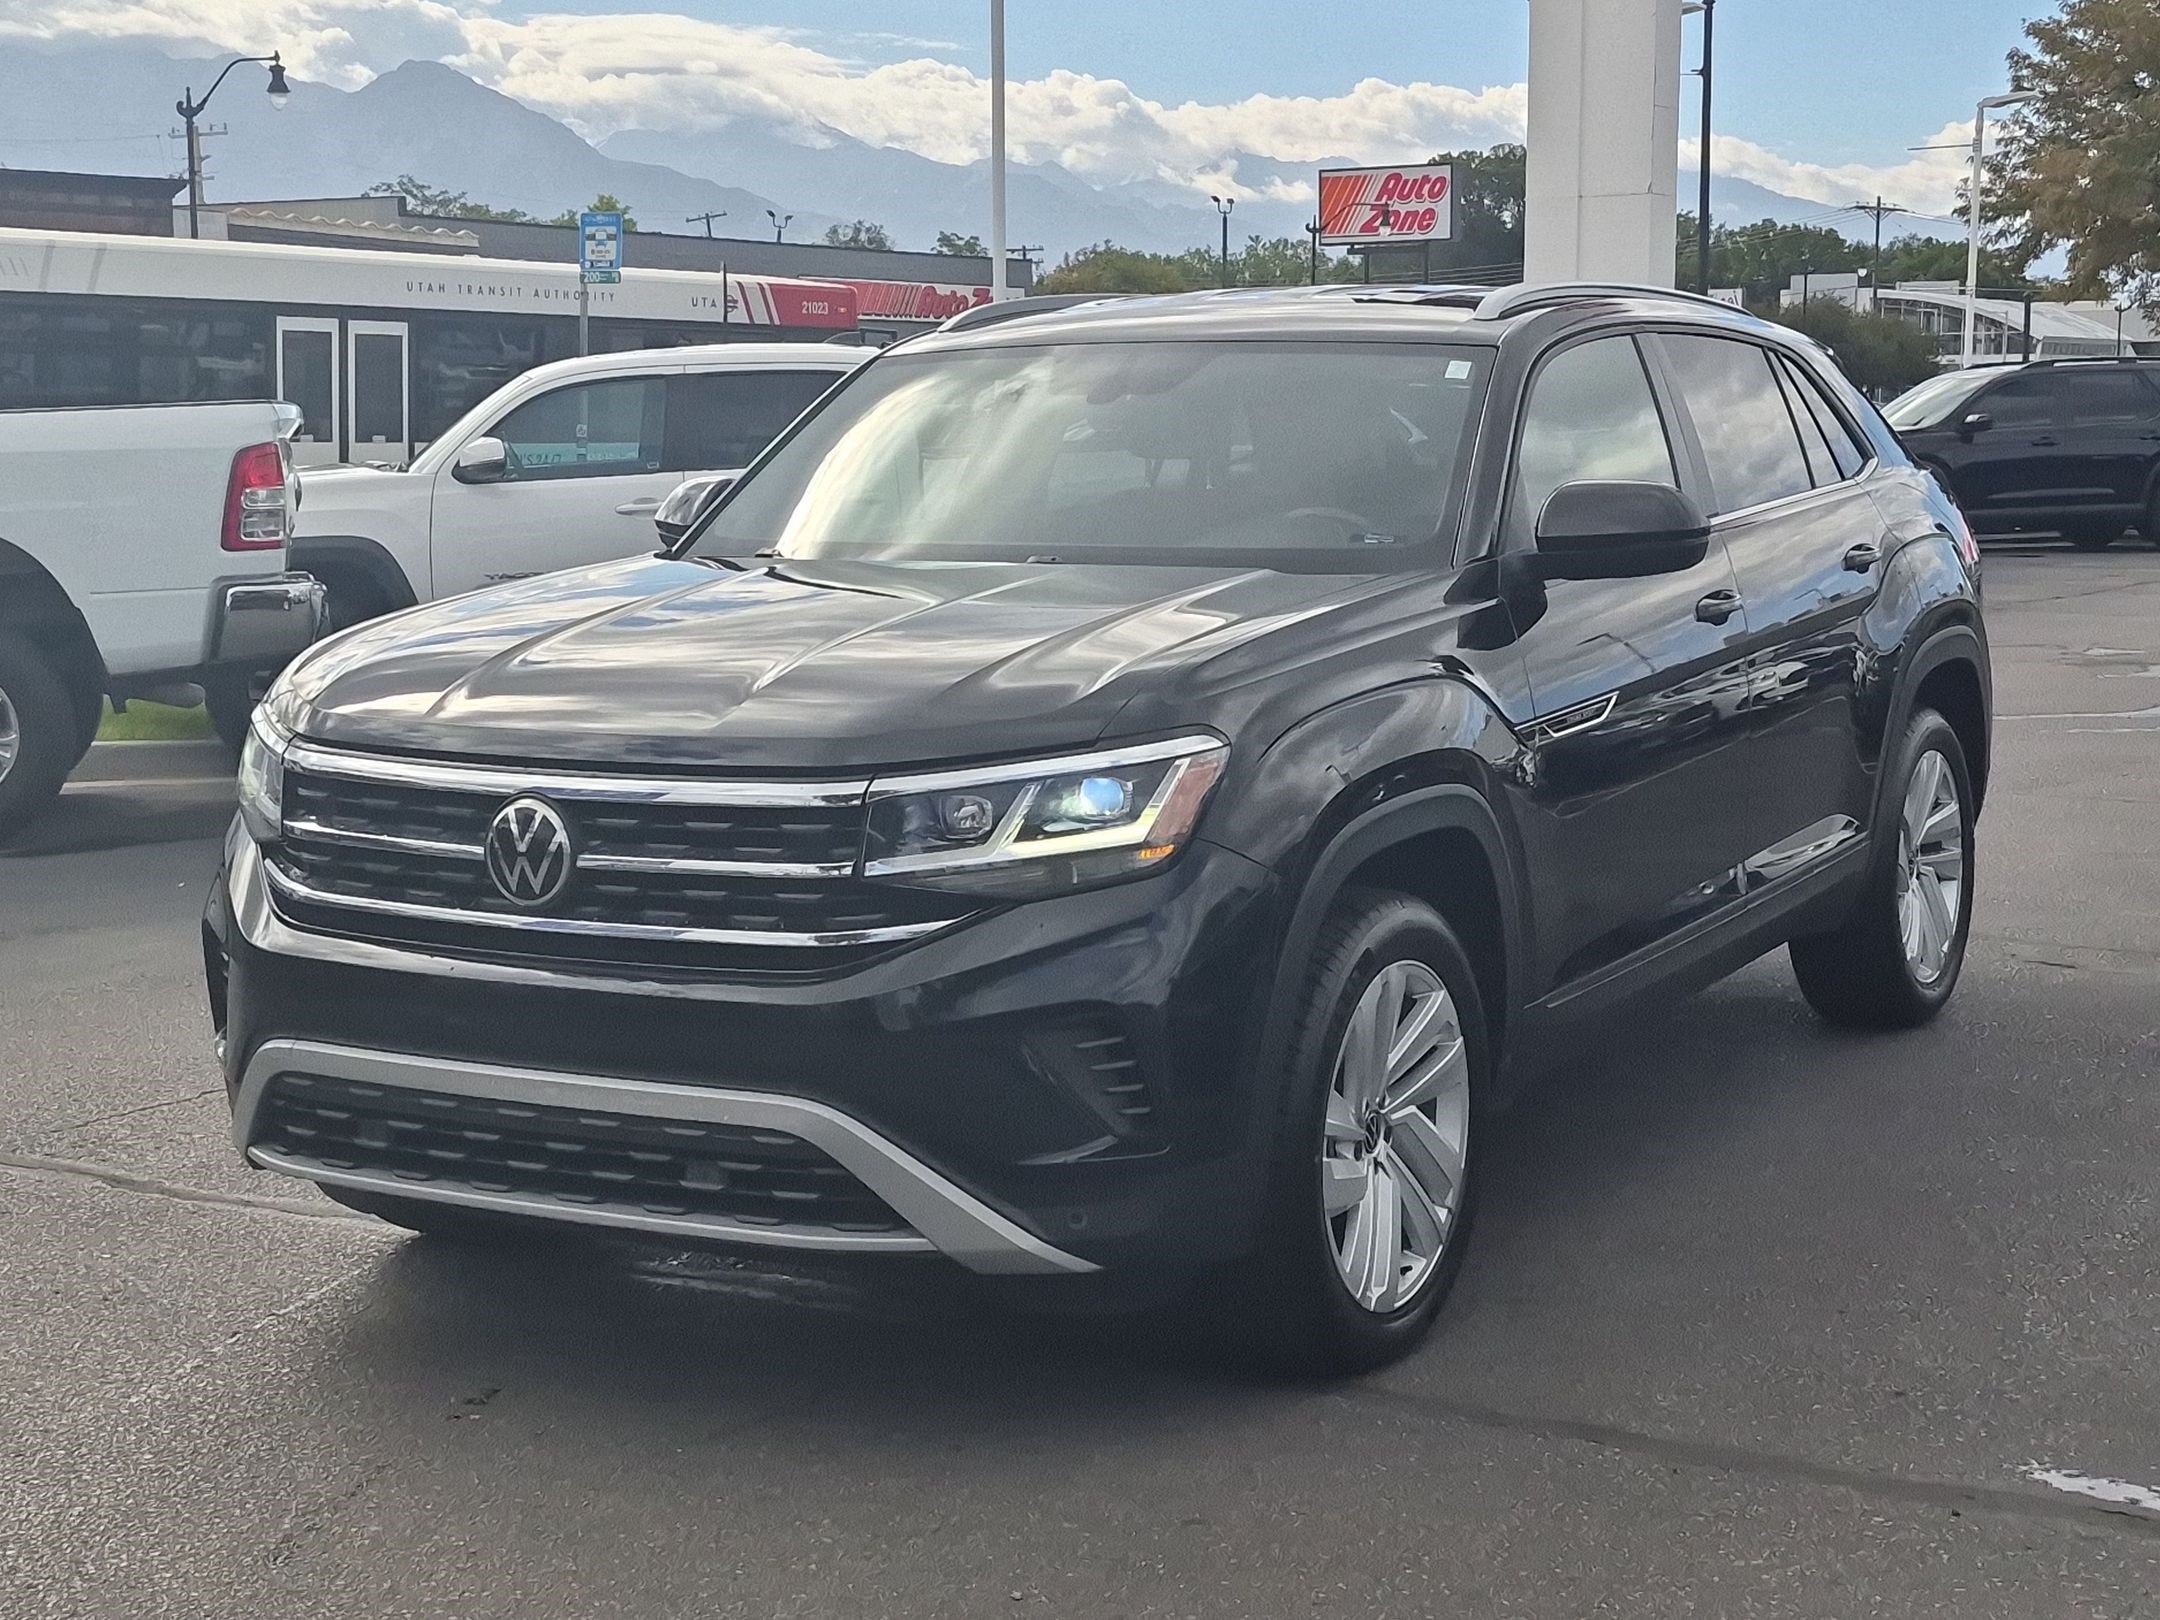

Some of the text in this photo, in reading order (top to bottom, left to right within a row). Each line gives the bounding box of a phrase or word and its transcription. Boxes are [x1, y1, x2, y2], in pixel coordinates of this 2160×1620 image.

[1374, 172, 1448, 203] Auto
[1358, 203, 1437, 234] Zone
[584, 271, 600, 283] 200
[406, 281, 614, 302] UTAH TRANSIT AUTHOITY
[691, 297, 717, 308] UTA
[801, 301, 829, 315] 21023
